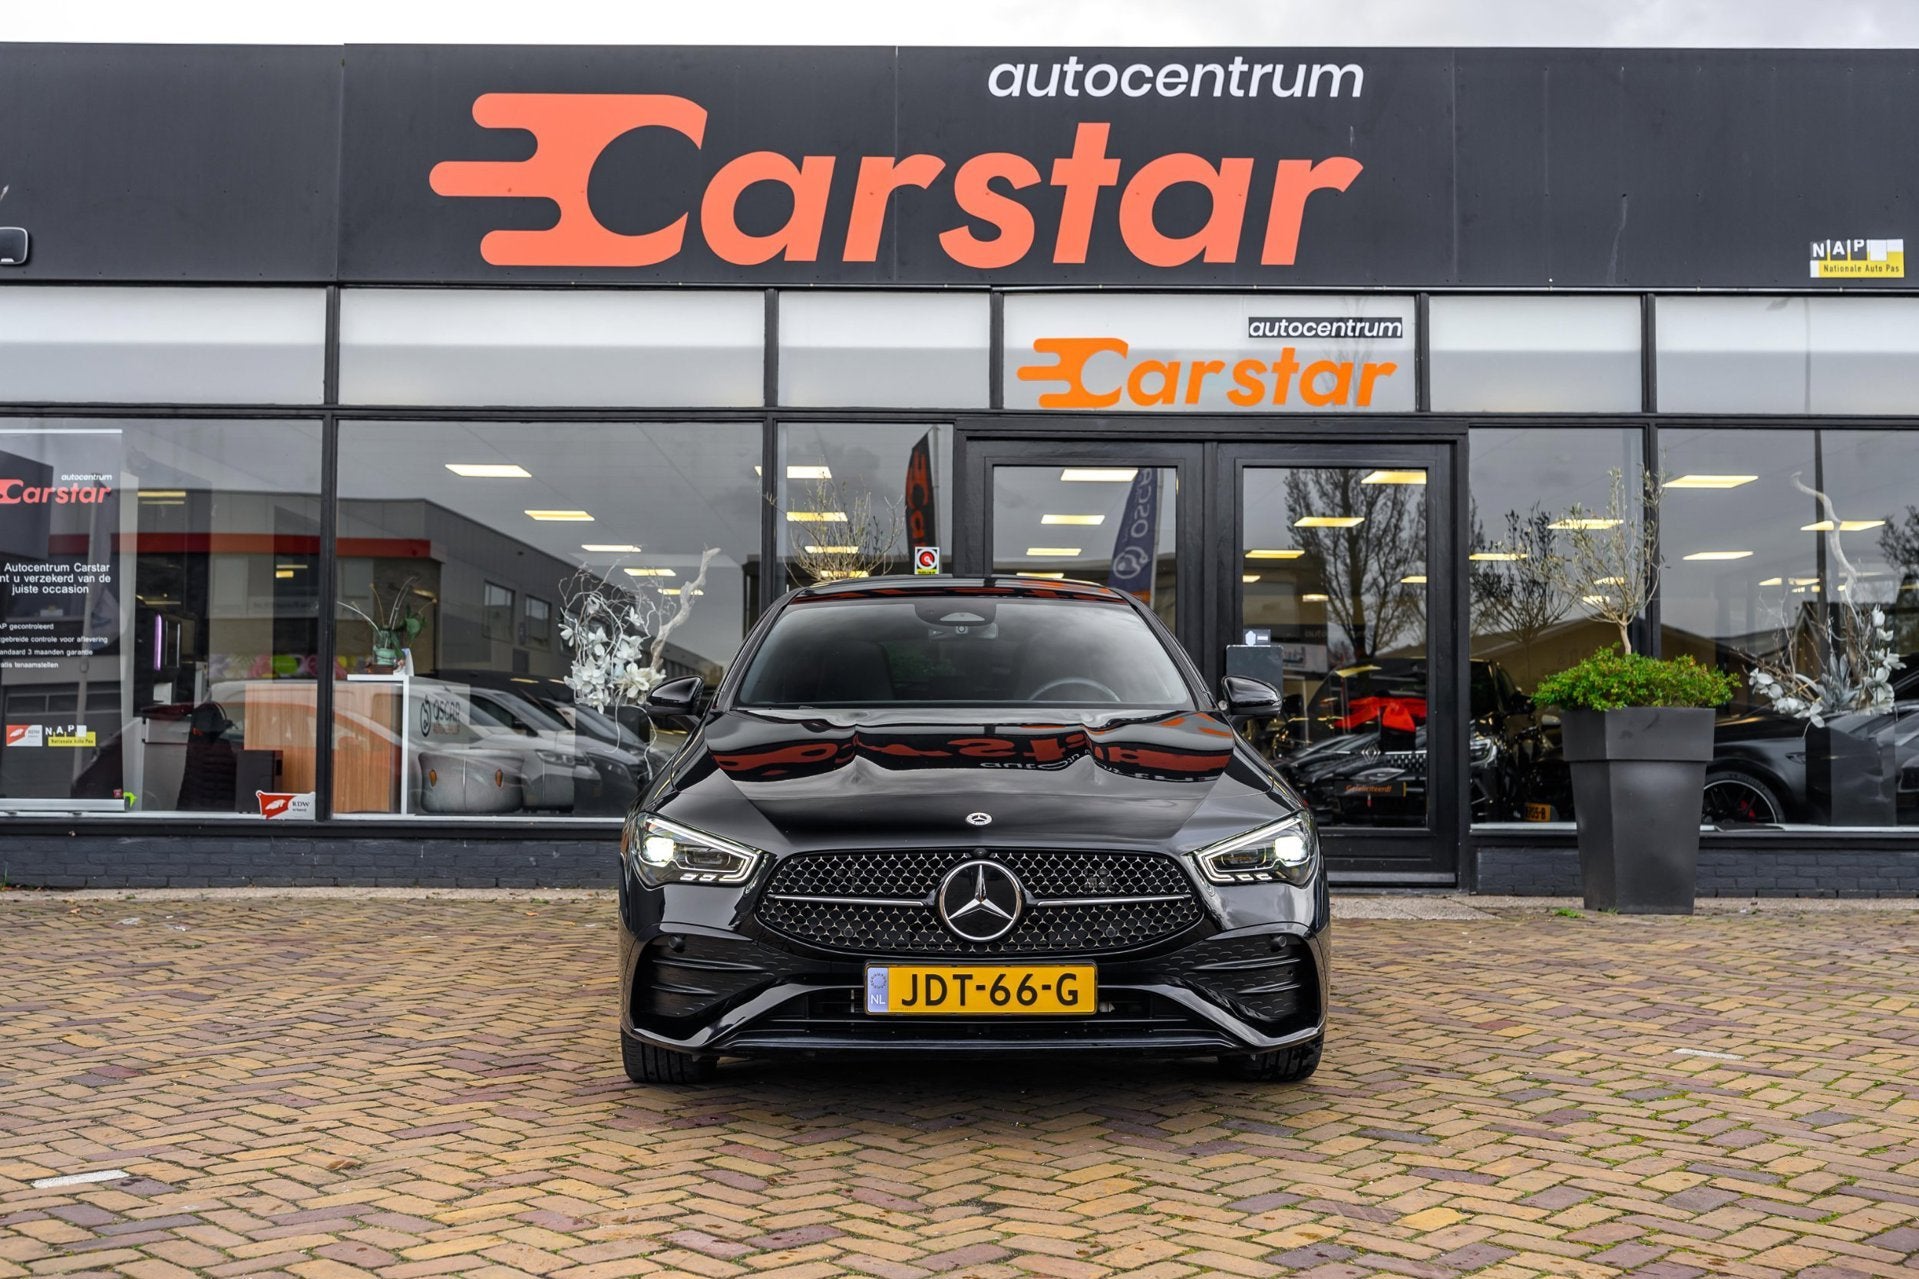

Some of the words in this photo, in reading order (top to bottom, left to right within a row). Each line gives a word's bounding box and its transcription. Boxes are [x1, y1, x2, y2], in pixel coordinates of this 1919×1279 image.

[988, 56, 1364, 99] autocentrum
[429, 92, 1363, 269] Carstar
[1823, 264, 1862, 273] Nationale
[1864, 264, 1884, 273] Auto
[1885, 264, 1901, 273] Pas
[1249, 319, 1402, 337] autocentrum
[1016, 337, 1397, 409] Carstar
[60, 473, 113, 481] autocentrum
[0, 478, 111, 504] Carstar
[4, 562, 70, 573] Autocentrum
[73, 562, 111, 573] Carstar
[13, 574, 20, 583] u
[24, 573, 74, 583] verzekerd
[77, 574, 96, 583] van
[98, 573, 112, 583] de
[11, 584, 39, 596] juiste
[42, 584, 90, 594] occasion
[9, 623, 55, 631] gecontroleerd
[901, 973, 1079, 1007] JDT-66-G
[870, 994, 886, 1005] NL
